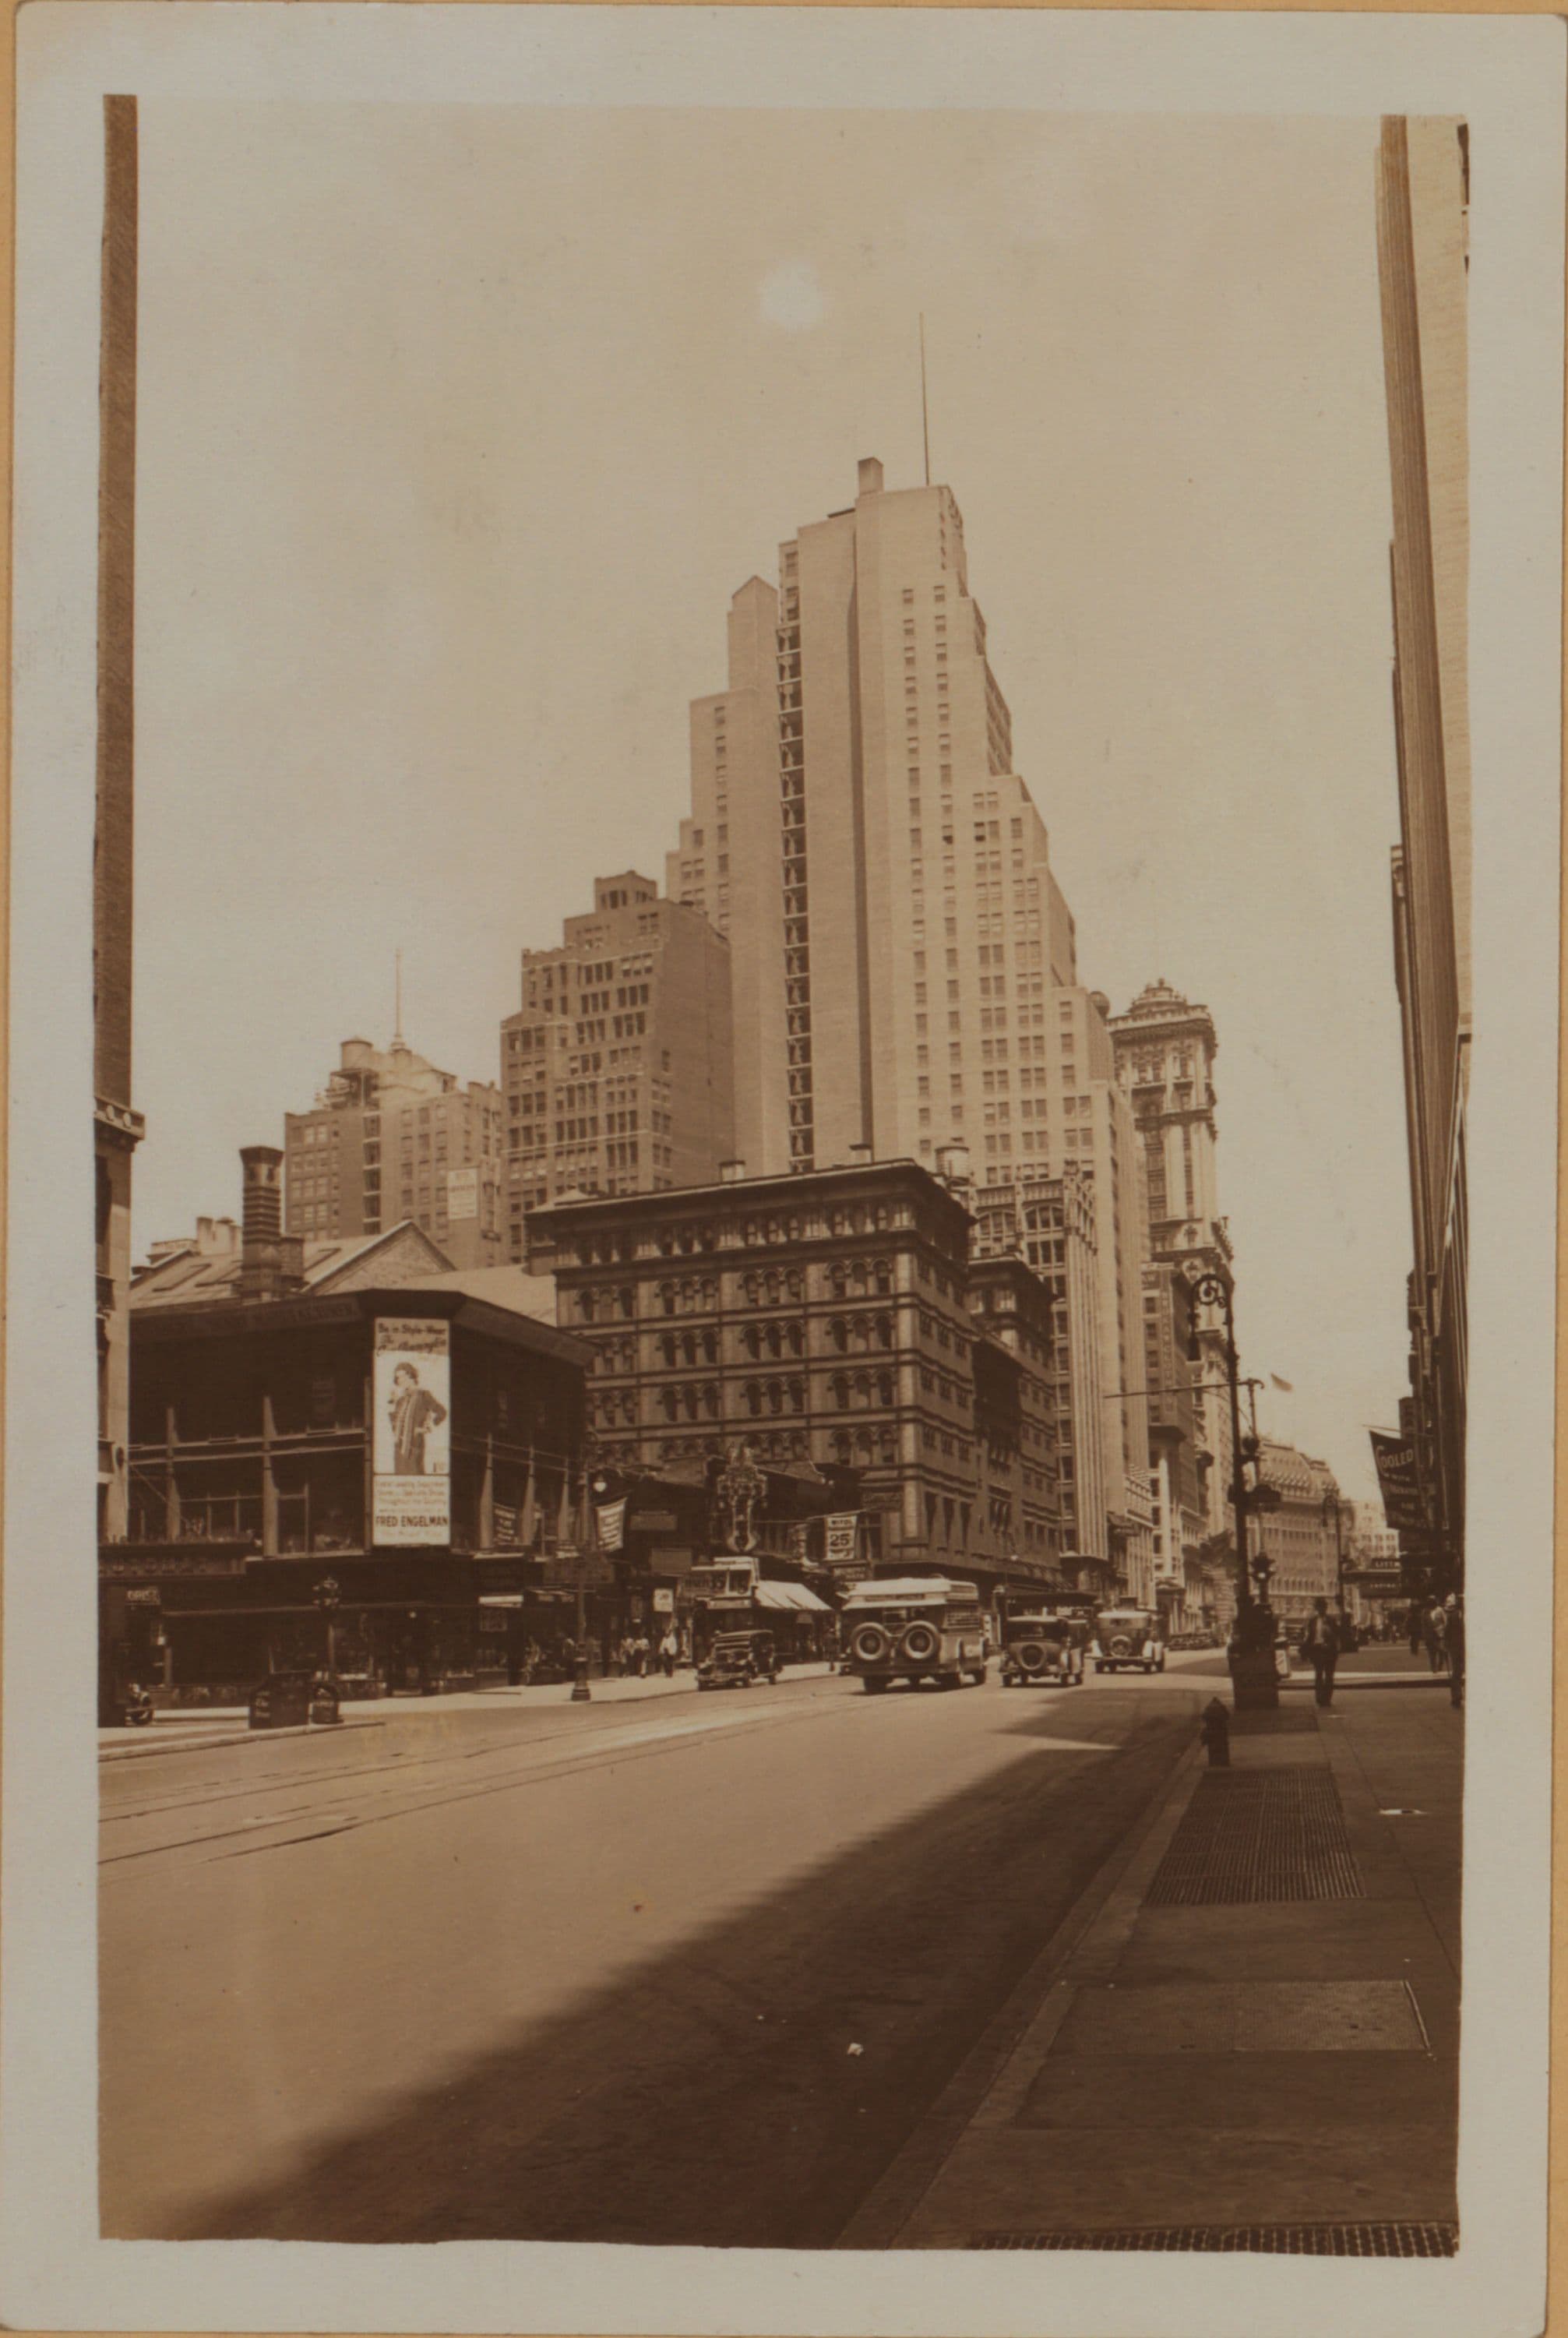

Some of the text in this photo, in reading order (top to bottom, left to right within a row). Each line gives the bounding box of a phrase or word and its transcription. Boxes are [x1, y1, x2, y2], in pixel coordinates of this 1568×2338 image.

[375, 1515, 448, 1527] FRED ENGELMAN
[830, 1533, 850, 1546] 25
